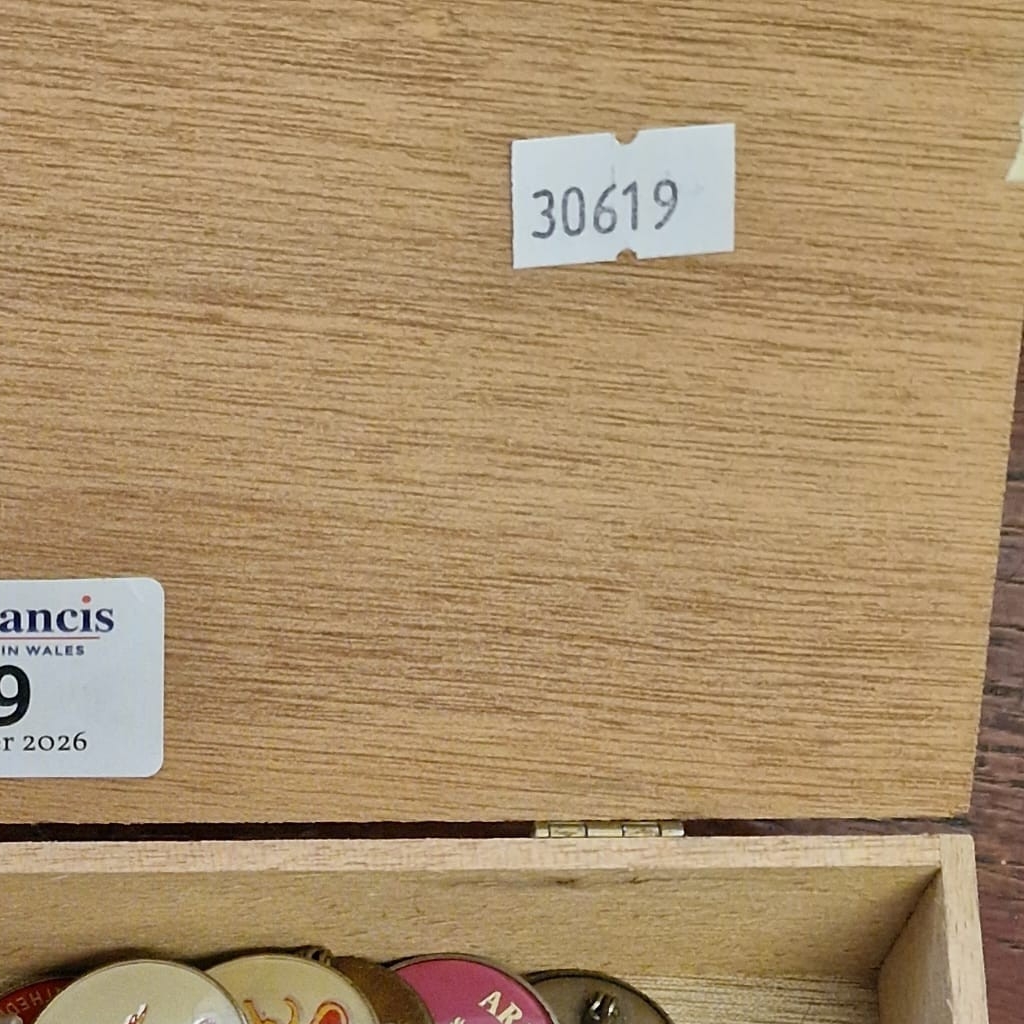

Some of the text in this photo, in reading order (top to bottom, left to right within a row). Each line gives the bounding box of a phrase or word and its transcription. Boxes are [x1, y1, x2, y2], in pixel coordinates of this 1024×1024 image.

[531, 178, 679, 240] 30619
[1, 645, 19, 657] IN
[26, 645, 86, 657] WALES
[23, 731, 88, 752] 2026
